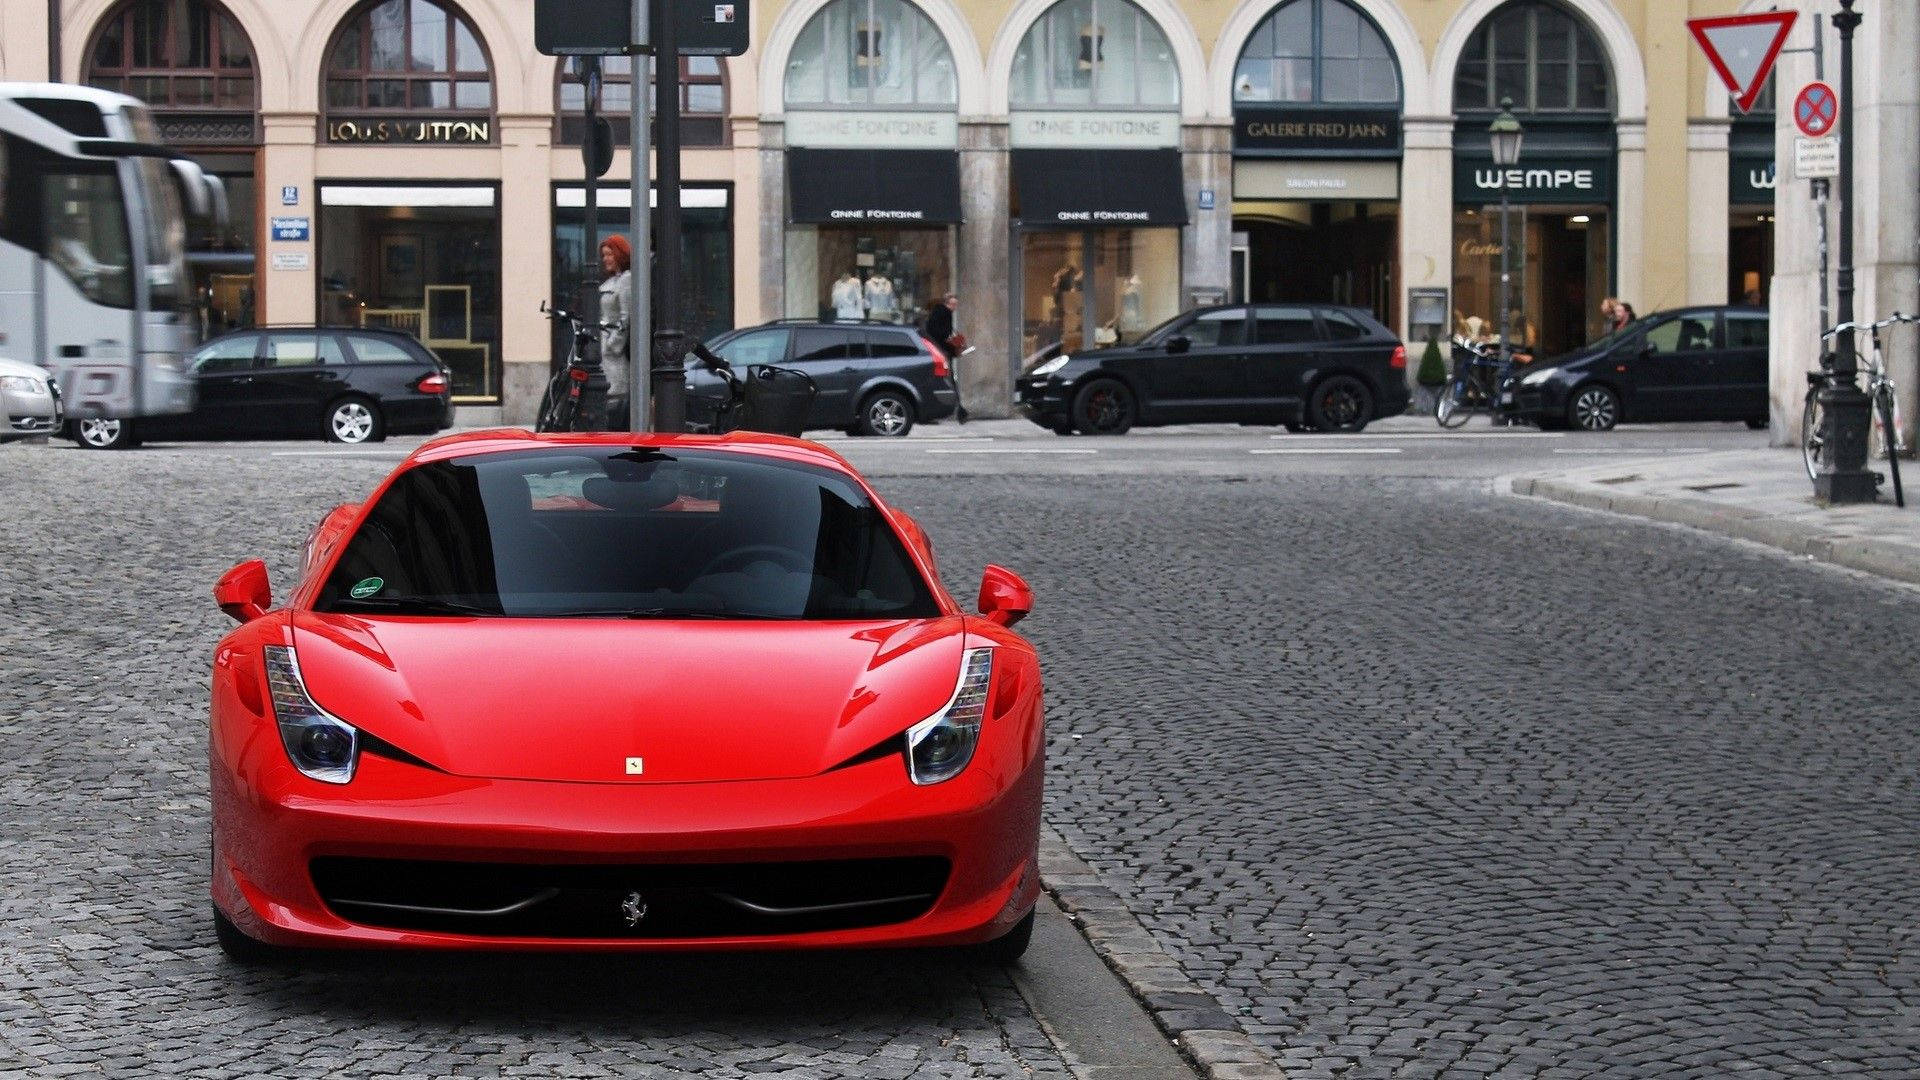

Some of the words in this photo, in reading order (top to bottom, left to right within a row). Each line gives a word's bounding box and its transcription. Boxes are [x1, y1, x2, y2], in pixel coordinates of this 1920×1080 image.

[329, 122, 389, 141] LOUS
[1248, 123, 1307, 137] GALERIE
[1308, 123, 1346, 137] FRED
[1348, 123, 1387, 139] JAHN
[1475, 169, 1593, 189] WEMPE
[830, 210, 863, 219] ANNE
[867, 210, 923, 219] FONTAINE
[1057, 211, 1090, 220] ANNE
[1094, 211, 1150, 220] FONTAINE
